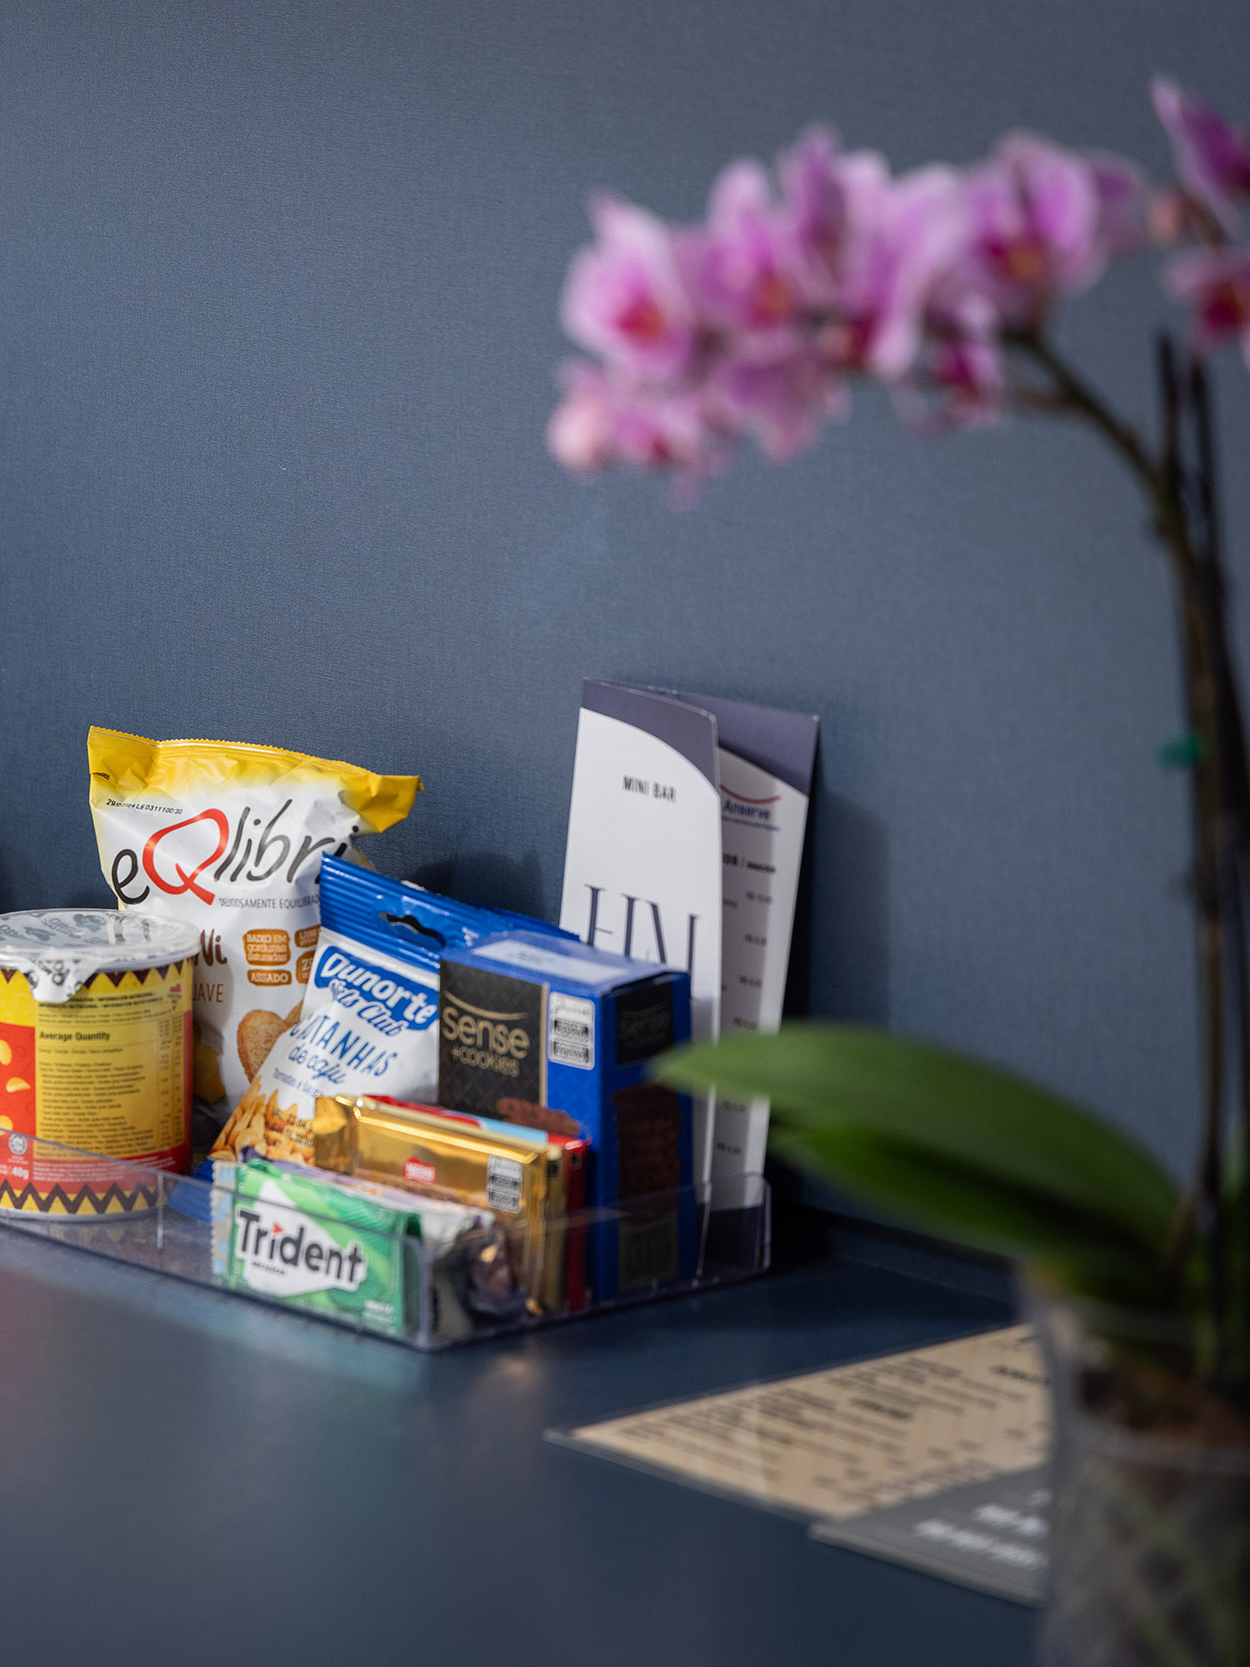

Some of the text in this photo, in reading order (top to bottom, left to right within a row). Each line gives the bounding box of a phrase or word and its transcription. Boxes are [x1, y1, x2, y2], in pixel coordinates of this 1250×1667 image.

[622, 775, 678, 802] MINI BAR
[250, 972, 289, 983] ASSADO
[320, 952, 437, 1024] Dunorte
[357, 1002, 407, 1036] Club
[443, 1007, 530, 1060] sense
[39, 1031, 111, 1042] Average Quantity
[307, 1054, 347, 1085] caju
[238, 1210, 363, 1284] Trident
